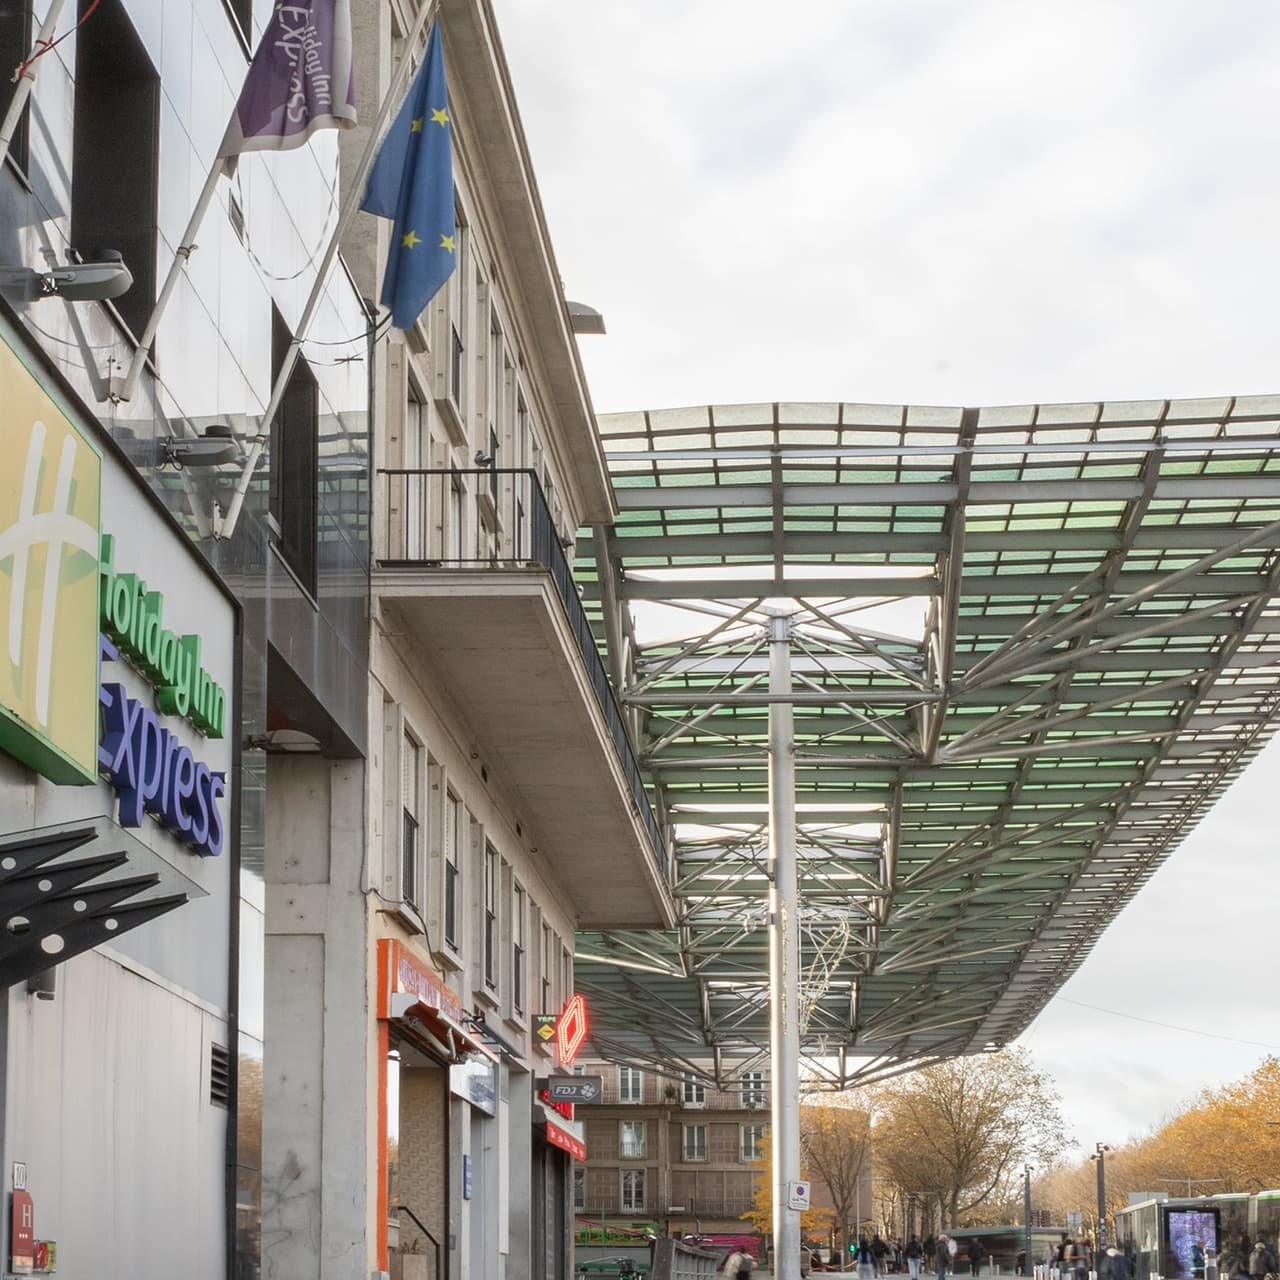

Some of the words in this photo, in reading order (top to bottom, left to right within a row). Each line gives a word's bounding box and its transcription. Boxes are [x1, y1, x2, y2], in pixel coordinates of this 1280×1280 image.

[312, 74, 331, 105] Inn
[182, 634, 226, 739] Inn
[555, 1086, 577, 1095] FDJ
